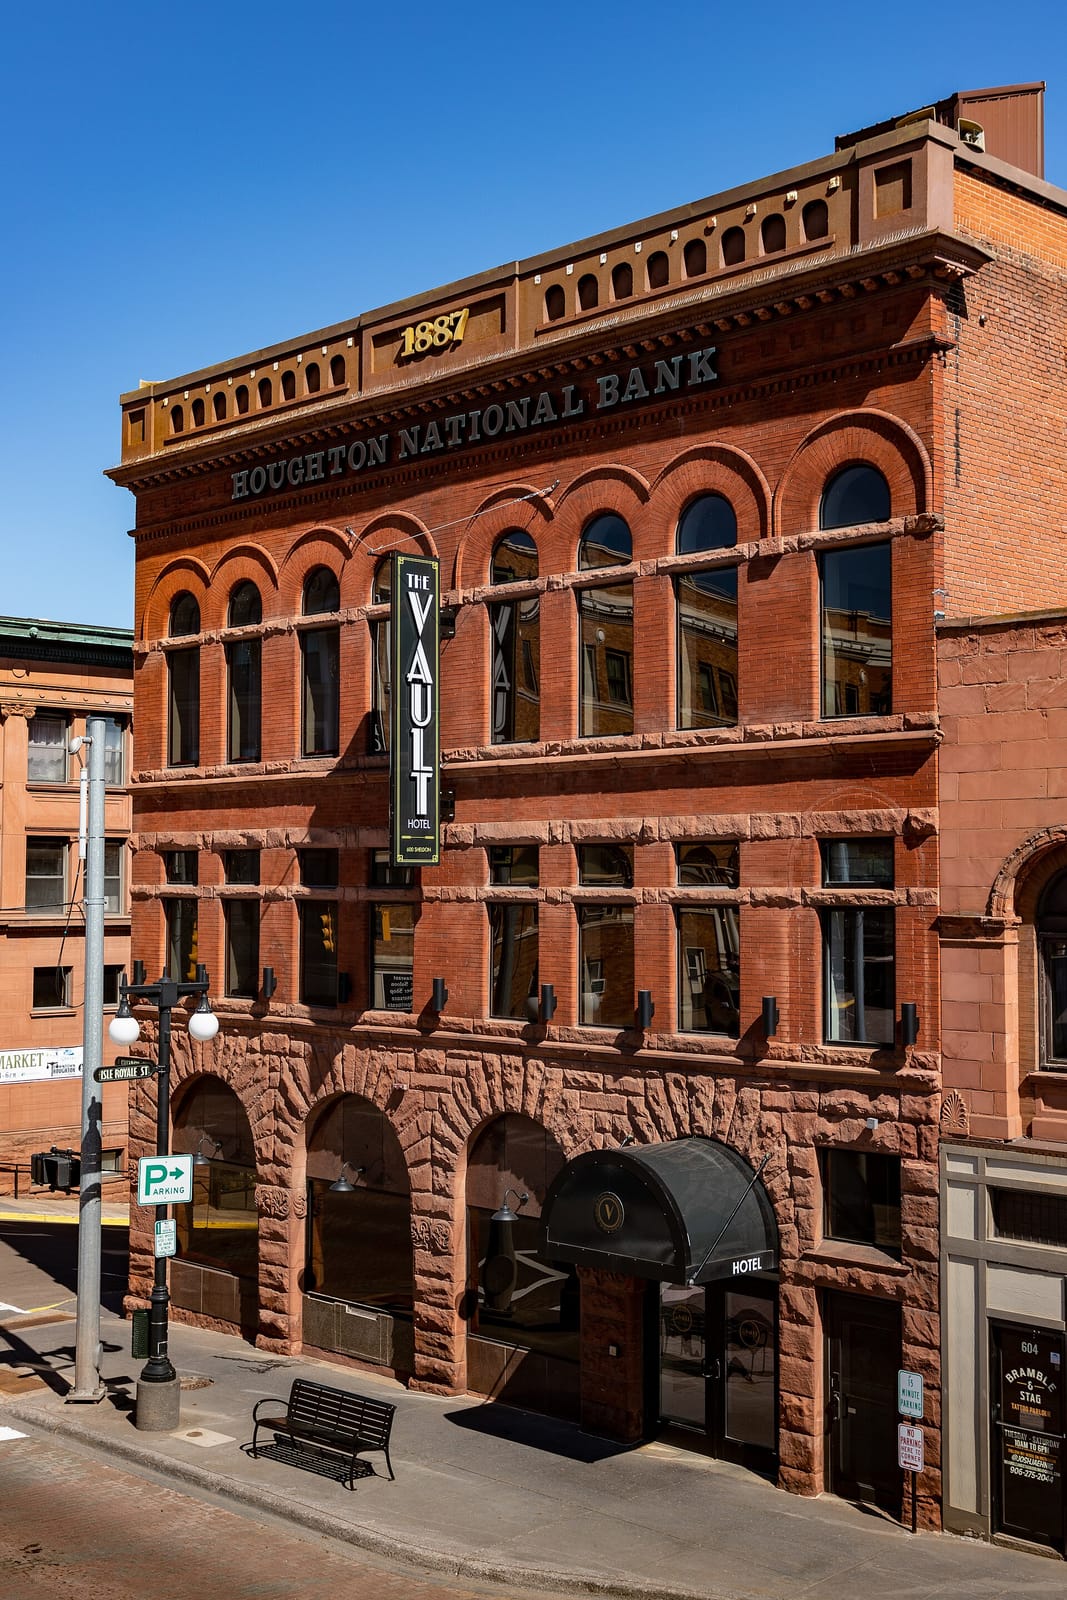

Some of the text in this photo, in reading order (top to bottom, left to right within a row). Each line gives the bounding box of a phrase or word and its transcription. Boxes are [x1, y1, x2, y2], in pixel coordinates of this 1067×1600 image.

[401, 308, 469, 357] 1887
[231, 346, 718, 500] HOUGHTON NATIONAL BANK
[406, 573, 429, 591] THE
[406, 591, 433, 815] VAULT
[407, 818, 431, 829] HOTEL
[100, 1069, 113, 1080] ISLE
[114, 1067, 137, 1079] ROYALE
[732, 1257, 762, 1275] HOTEL
[1021, 1341, 1039, 1355] 604
[907, 1378, 914, 1388] 15
[1005, 1367, 1057, 1393] BRAMBLE
[1027, 1380, 1034, 1391] &
[901, 1388, 920, 1400] MINUTE
[1019, 1390, 1042, 1405] STAG
[900, 1398, 921, 1411] PARKING
[906, 1429, 915, 1438] NO
[1004, 1428, 1027, 1440] TUESDAY
[1031, 1436, 1060, 1448] SATURDAY
[900, 1436, 921, 1449] PARKING
[1014, 1439, 1050, 1454] 10AM TO 6PM
[900, 1452, 921, 1462] CORNER
[901, 1445, 921, 1456] HERE TO
[1010, 1466, 1054, 1483] 906-275-2044
